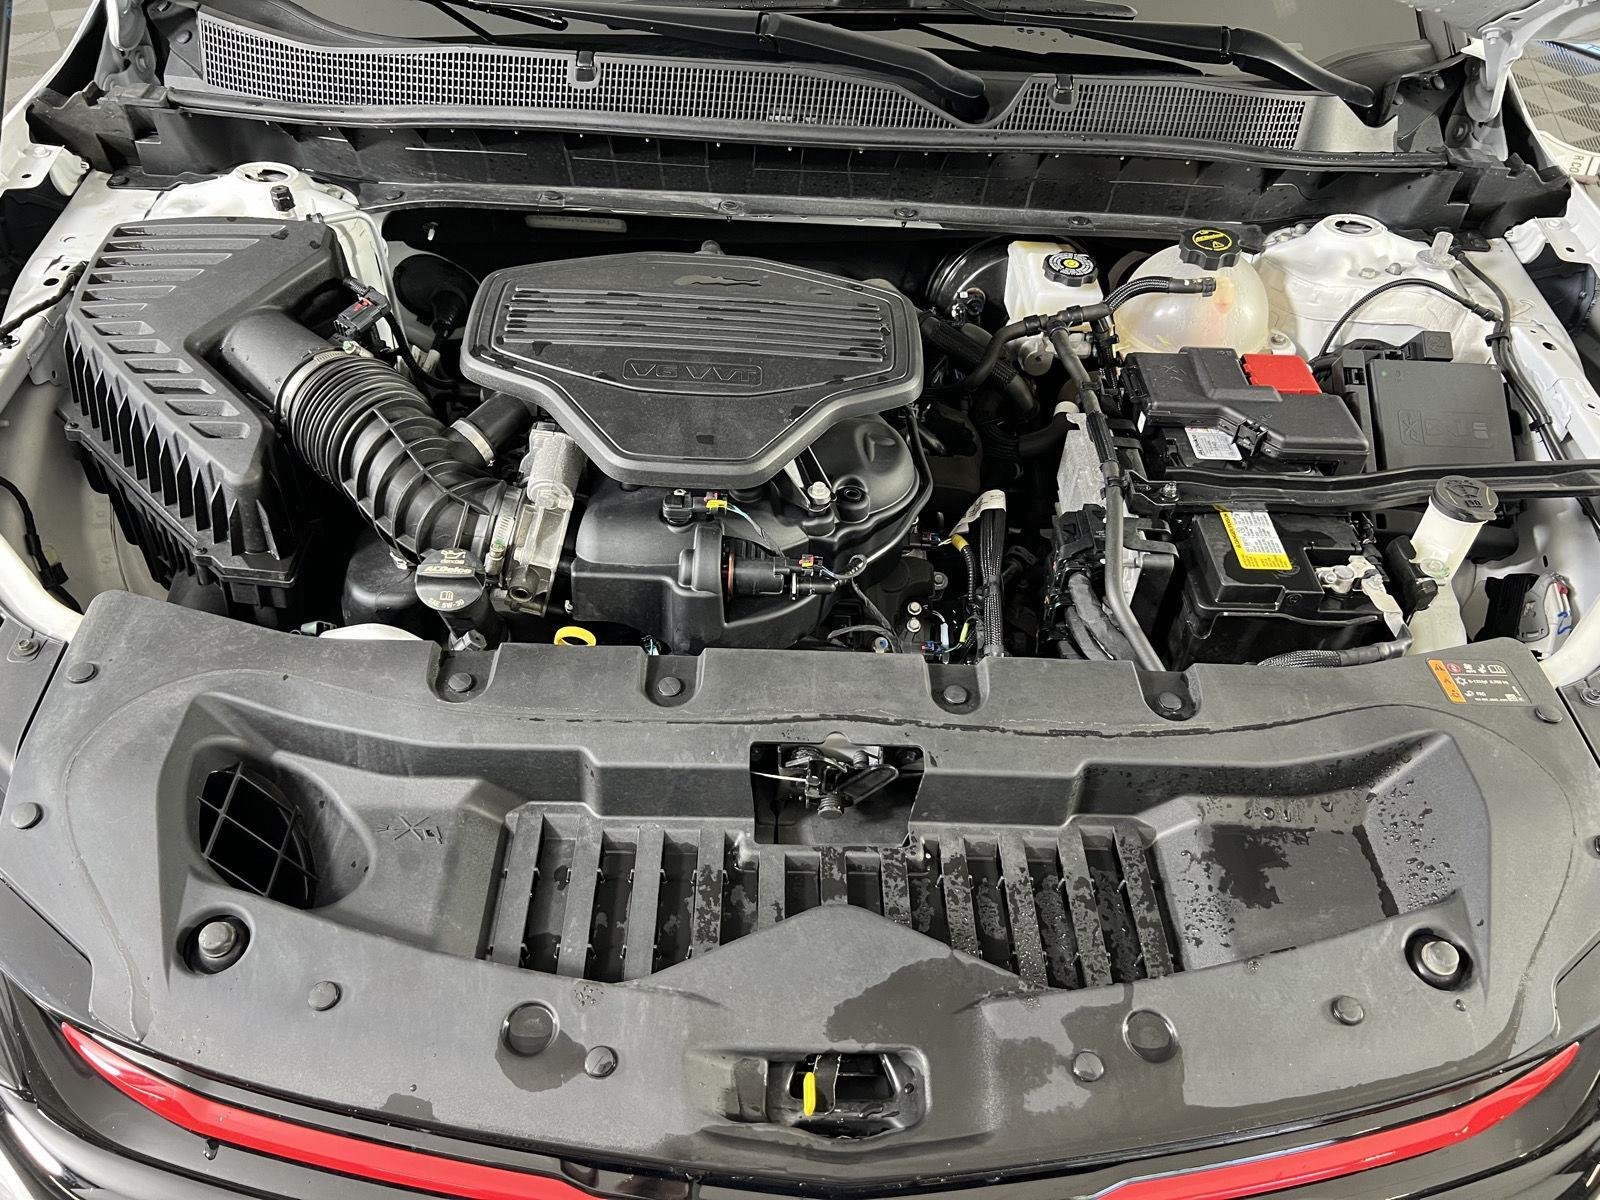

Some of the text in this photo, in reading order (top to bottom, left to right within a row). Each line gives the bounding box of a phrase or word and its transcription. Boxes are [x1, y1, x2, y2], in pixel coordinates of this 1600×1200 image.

[630, 363, 757, 382] V6 VVT
[424, 566, 472, 574] ACDelco
[428, 598, 465, 609] SAE 5W-30
